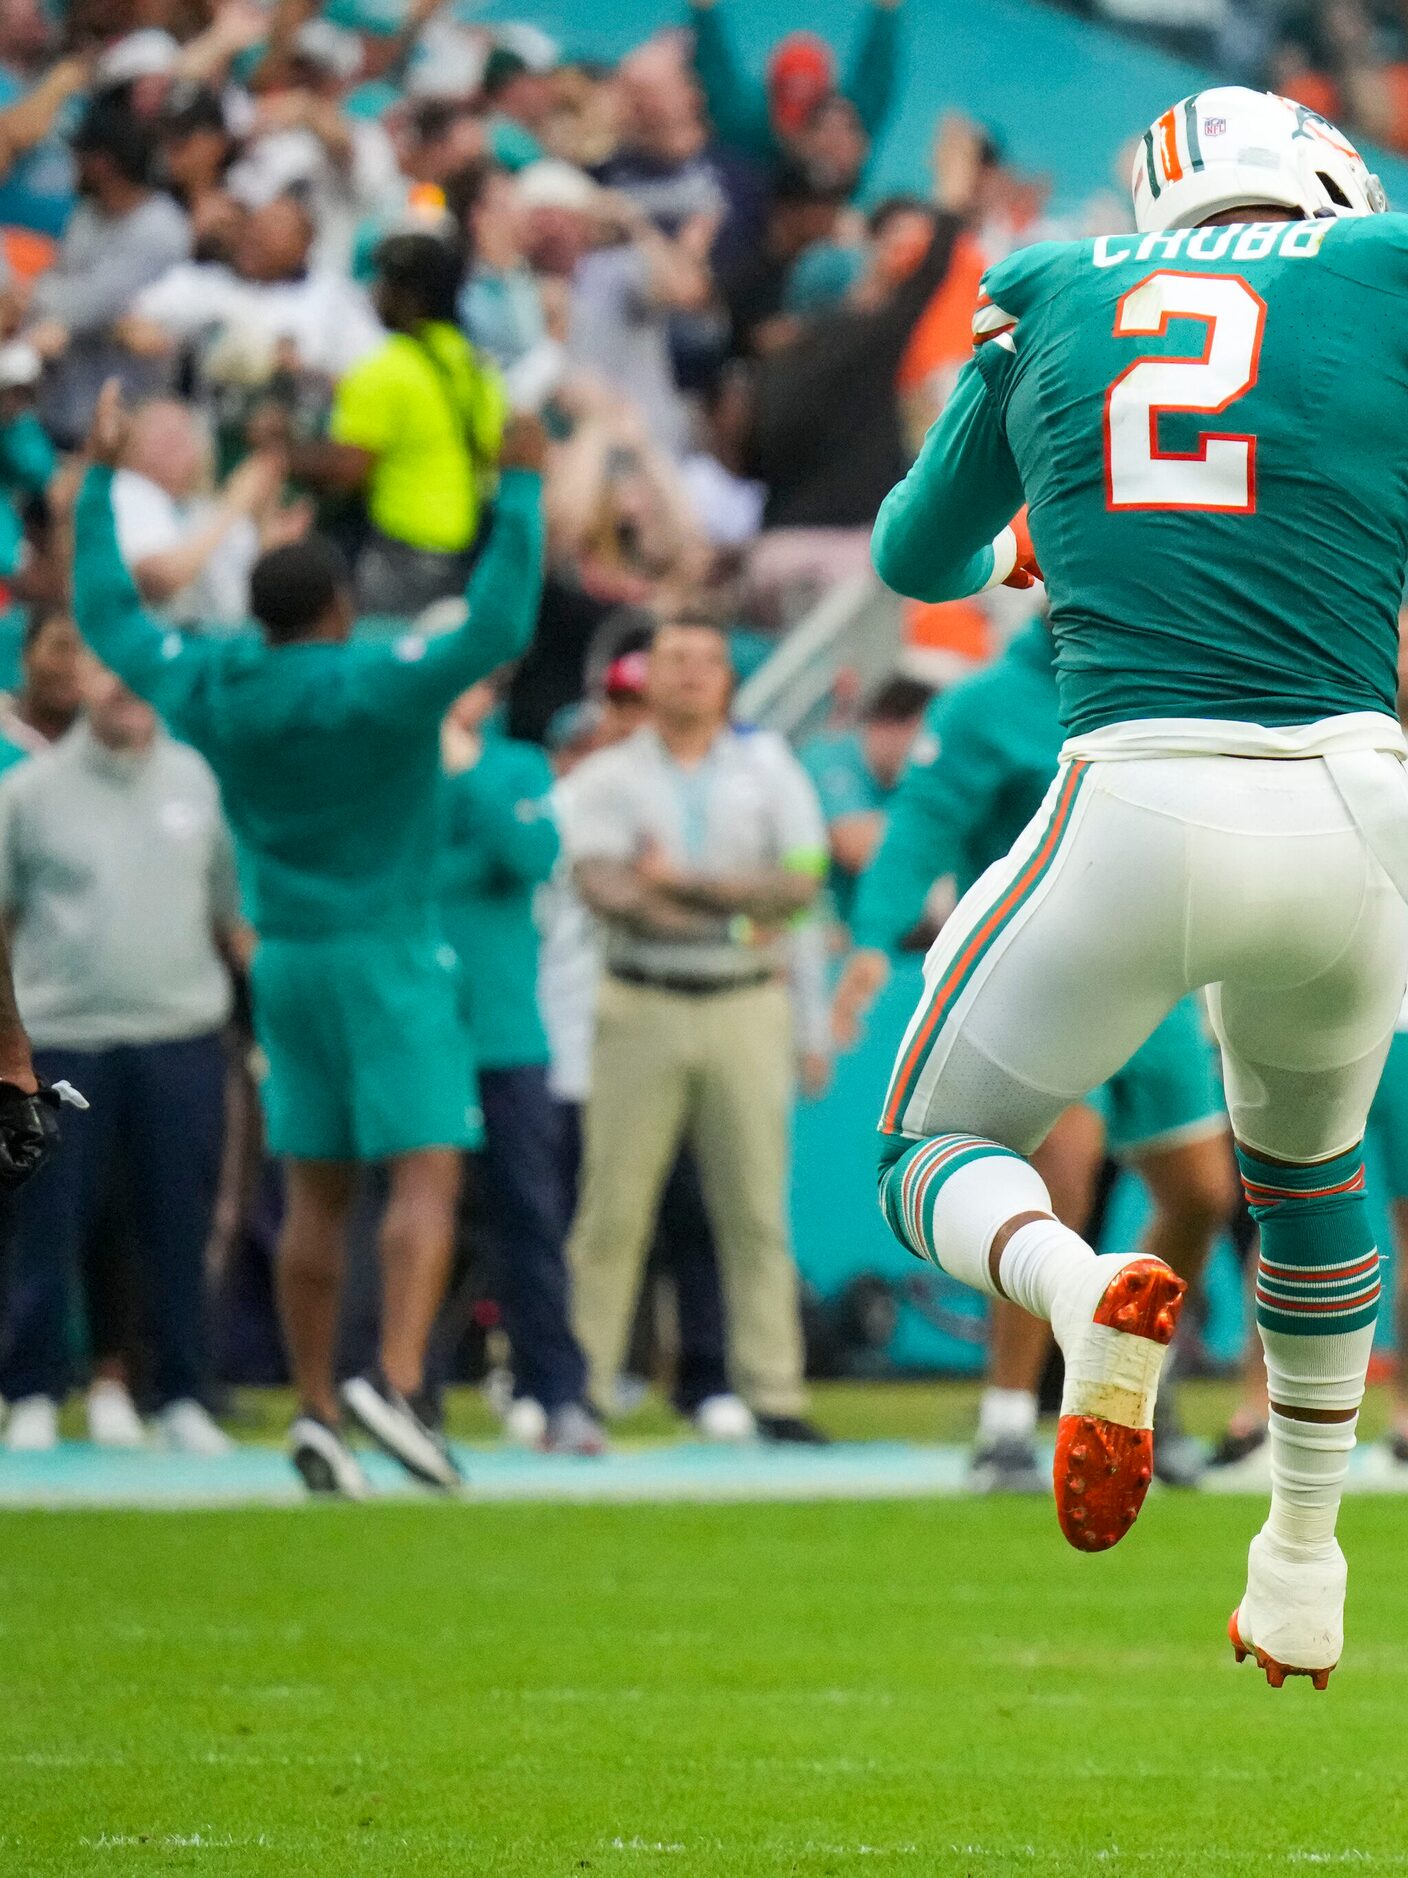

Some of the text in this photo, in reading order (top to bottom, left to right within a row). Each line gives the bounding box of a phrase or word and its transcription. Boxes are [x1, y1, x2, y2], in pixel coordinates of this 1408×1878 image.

[1206, 124, 1225, 134] NFL
[1093, 217, 1338, 268] CHUBB
[1102, 268, 1268, 515] 2
